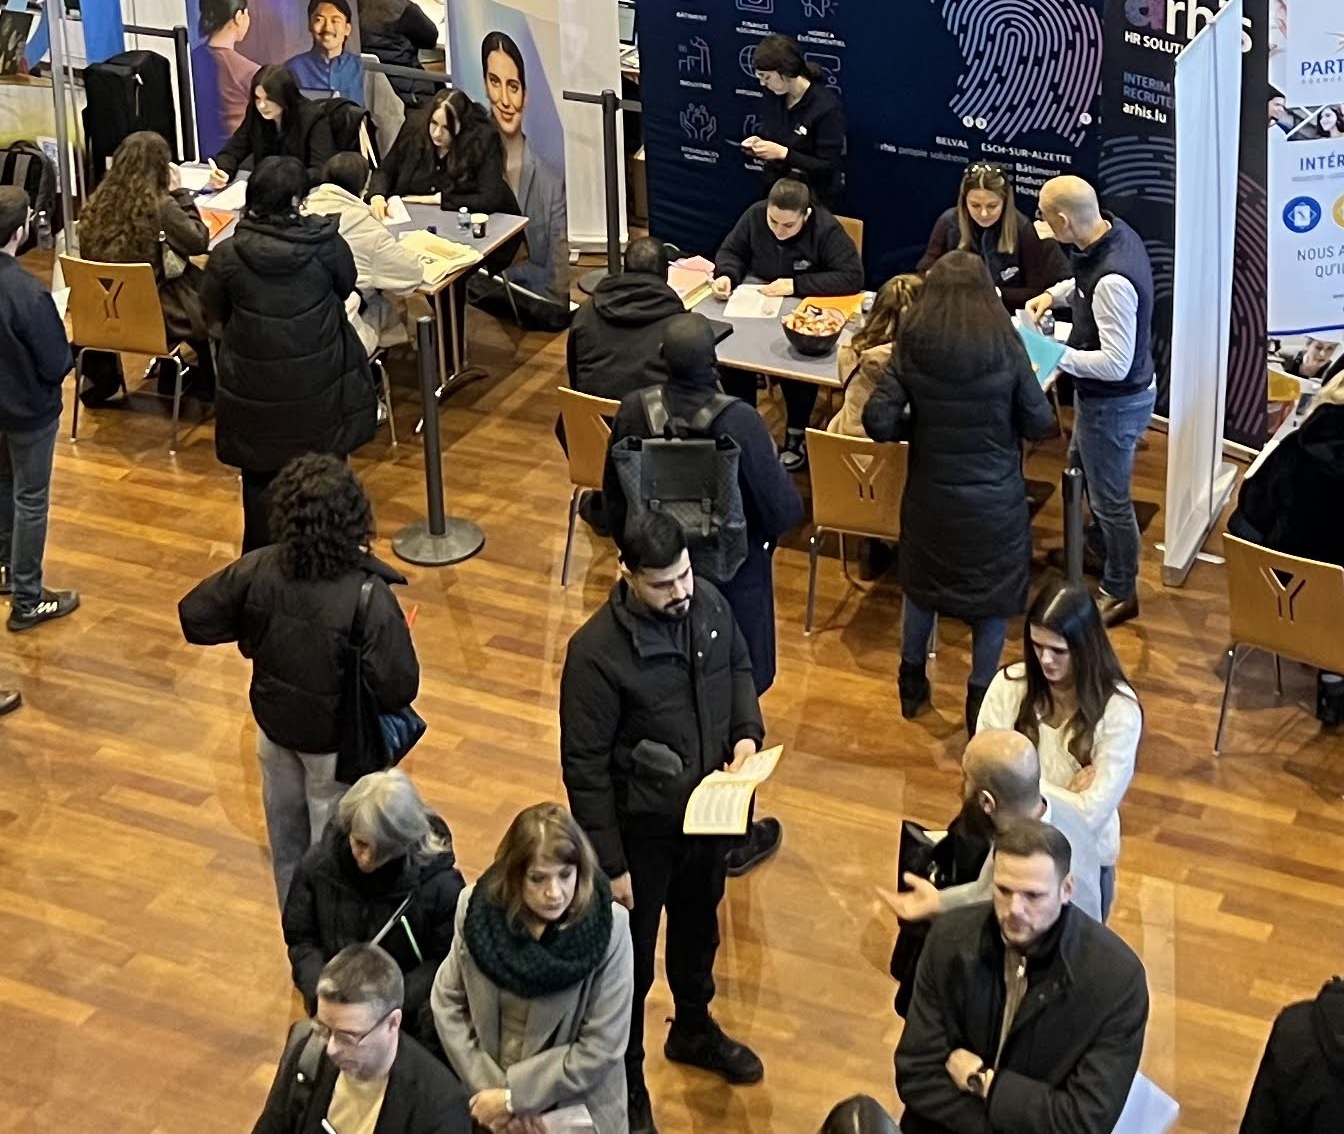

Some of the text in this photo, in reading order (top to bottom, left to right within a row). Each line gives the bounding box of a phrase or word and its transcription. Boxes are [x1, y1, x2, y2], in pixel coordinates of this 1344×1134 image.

[1124, 30, 1141, 46] HR
[1123, 71, 1171, 93] INTERIM
[1123, 102, 1167, 124] arhis.lu
[935, 136, 969, 150] BELVAL
[981, 142, 1072, 164] ESCH-SUR-ALZETTE
[1297, 245, 1334, 261] NOUS
